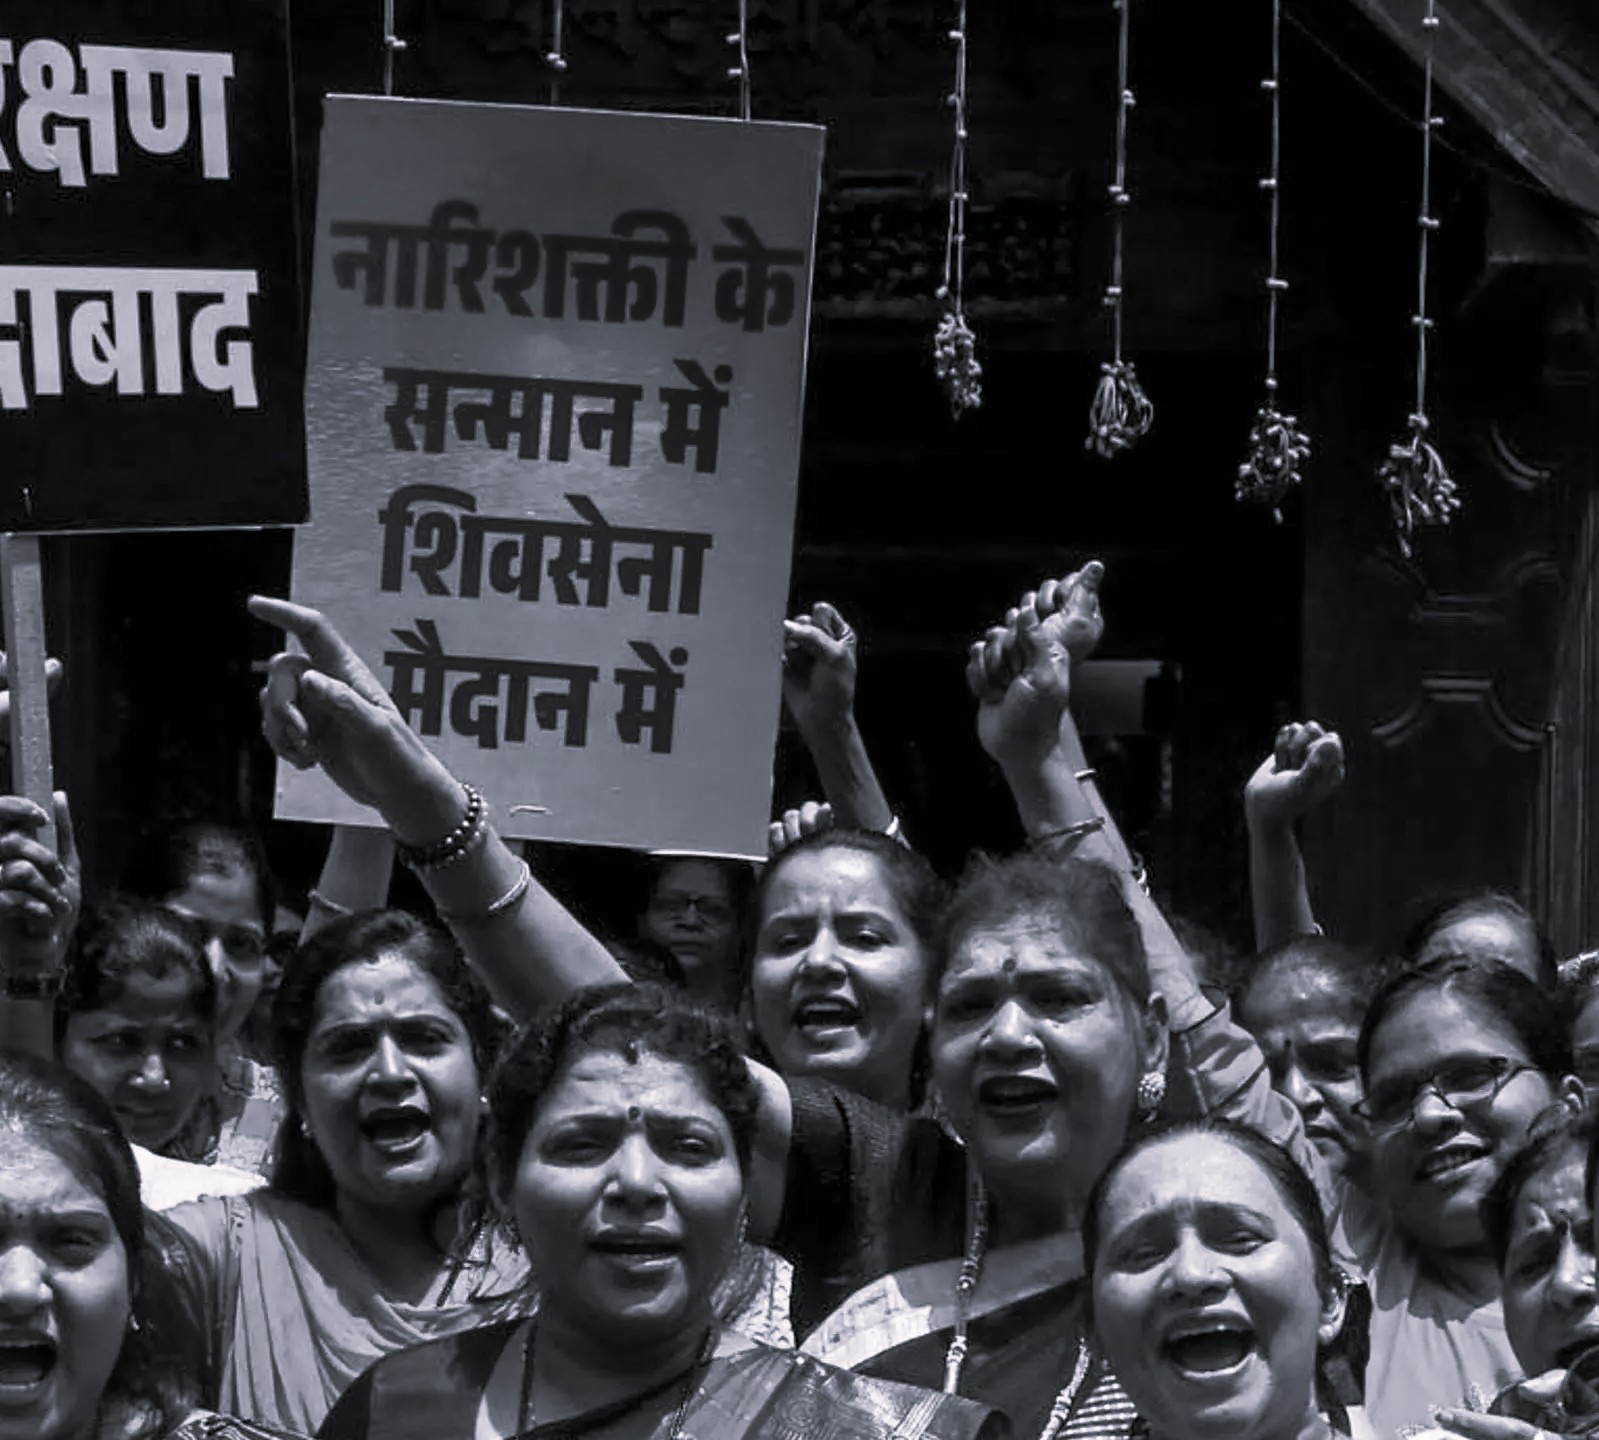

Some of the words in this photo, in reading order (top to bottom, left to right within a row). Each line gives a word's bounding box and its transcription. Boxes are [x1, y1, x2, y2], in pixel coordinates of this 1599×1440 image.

[330, 200, 697, 328] नारिशक्ती
[712, 215, 805, 333] के
[383, 367, 643, 467] सन्मान
[660, 358, 734, 474] में
[378, 484, 713, 615] शिवसेना
[384, 619, 599, 750] मैदान
[614, 640, 689, 755] में
